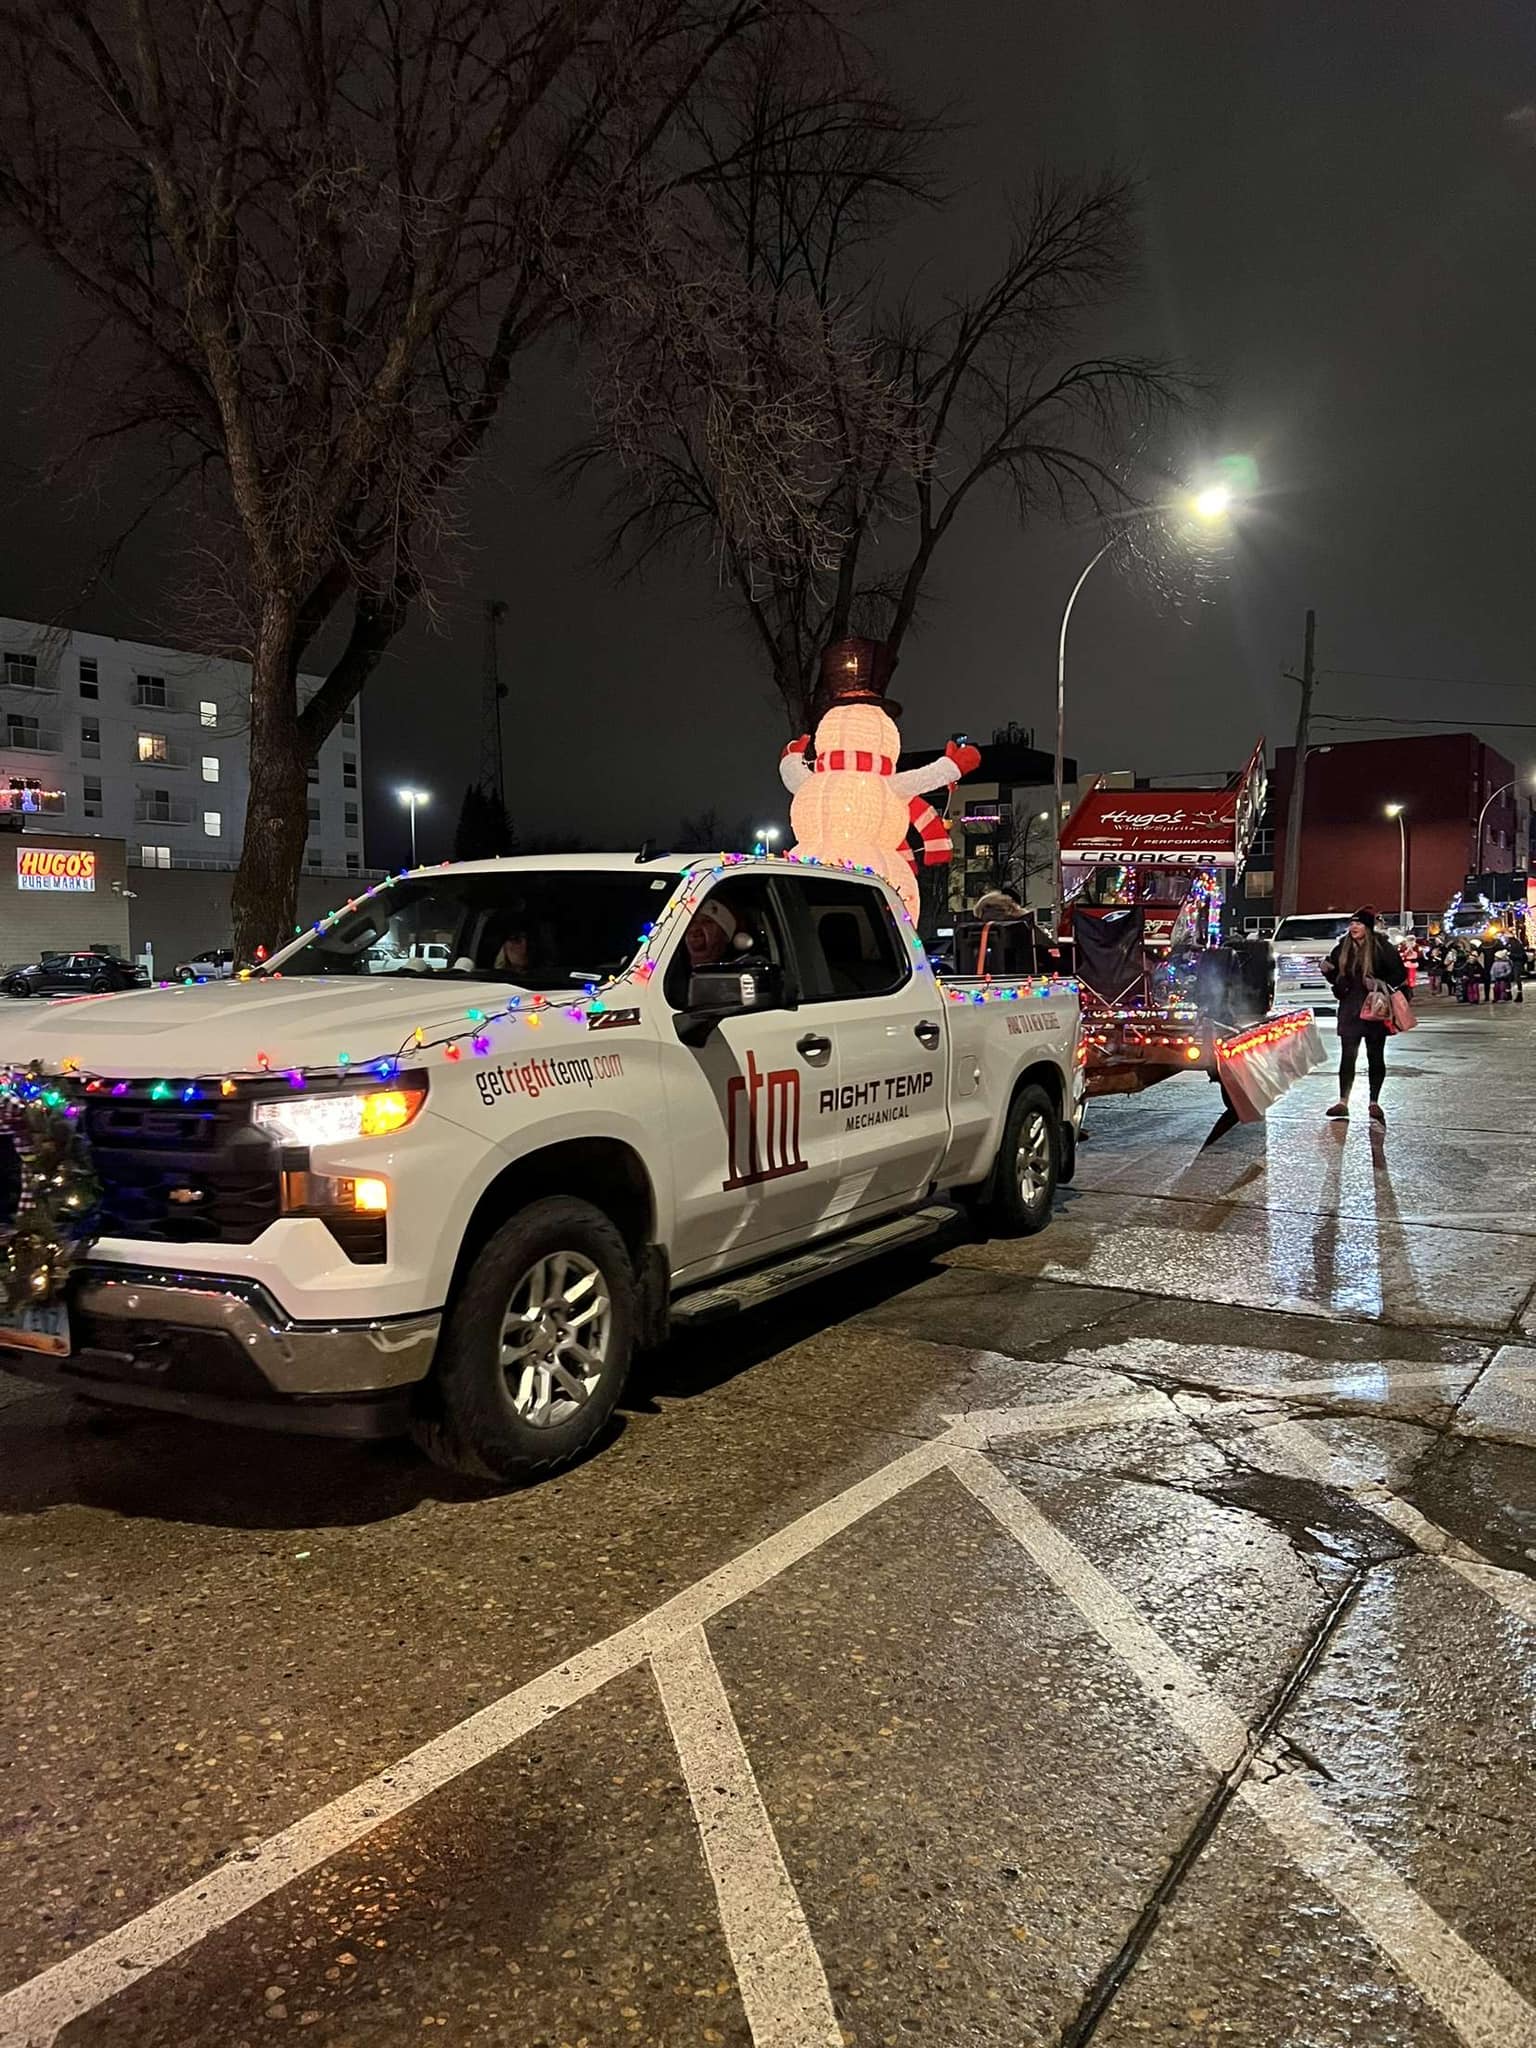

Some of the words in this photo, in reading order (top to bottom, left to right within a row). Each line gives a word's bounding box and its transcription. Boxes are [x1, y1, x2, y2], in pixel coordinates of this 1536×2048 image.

[1100, 810, 1187, 827] Hugo's
[21, 851, 95, 877] HUGO'S
[1080, 851, 1217, 865] CROAKER
[22, 876, 49, 889] PURE
[475, 1053, 624, 1106] getrighttemp.com
[819, 1080, 881, 1114] RIGHT
[884, 1071, 933, 1100] TEMP
[845, 1104, 910, 1132] MECHANICAL
